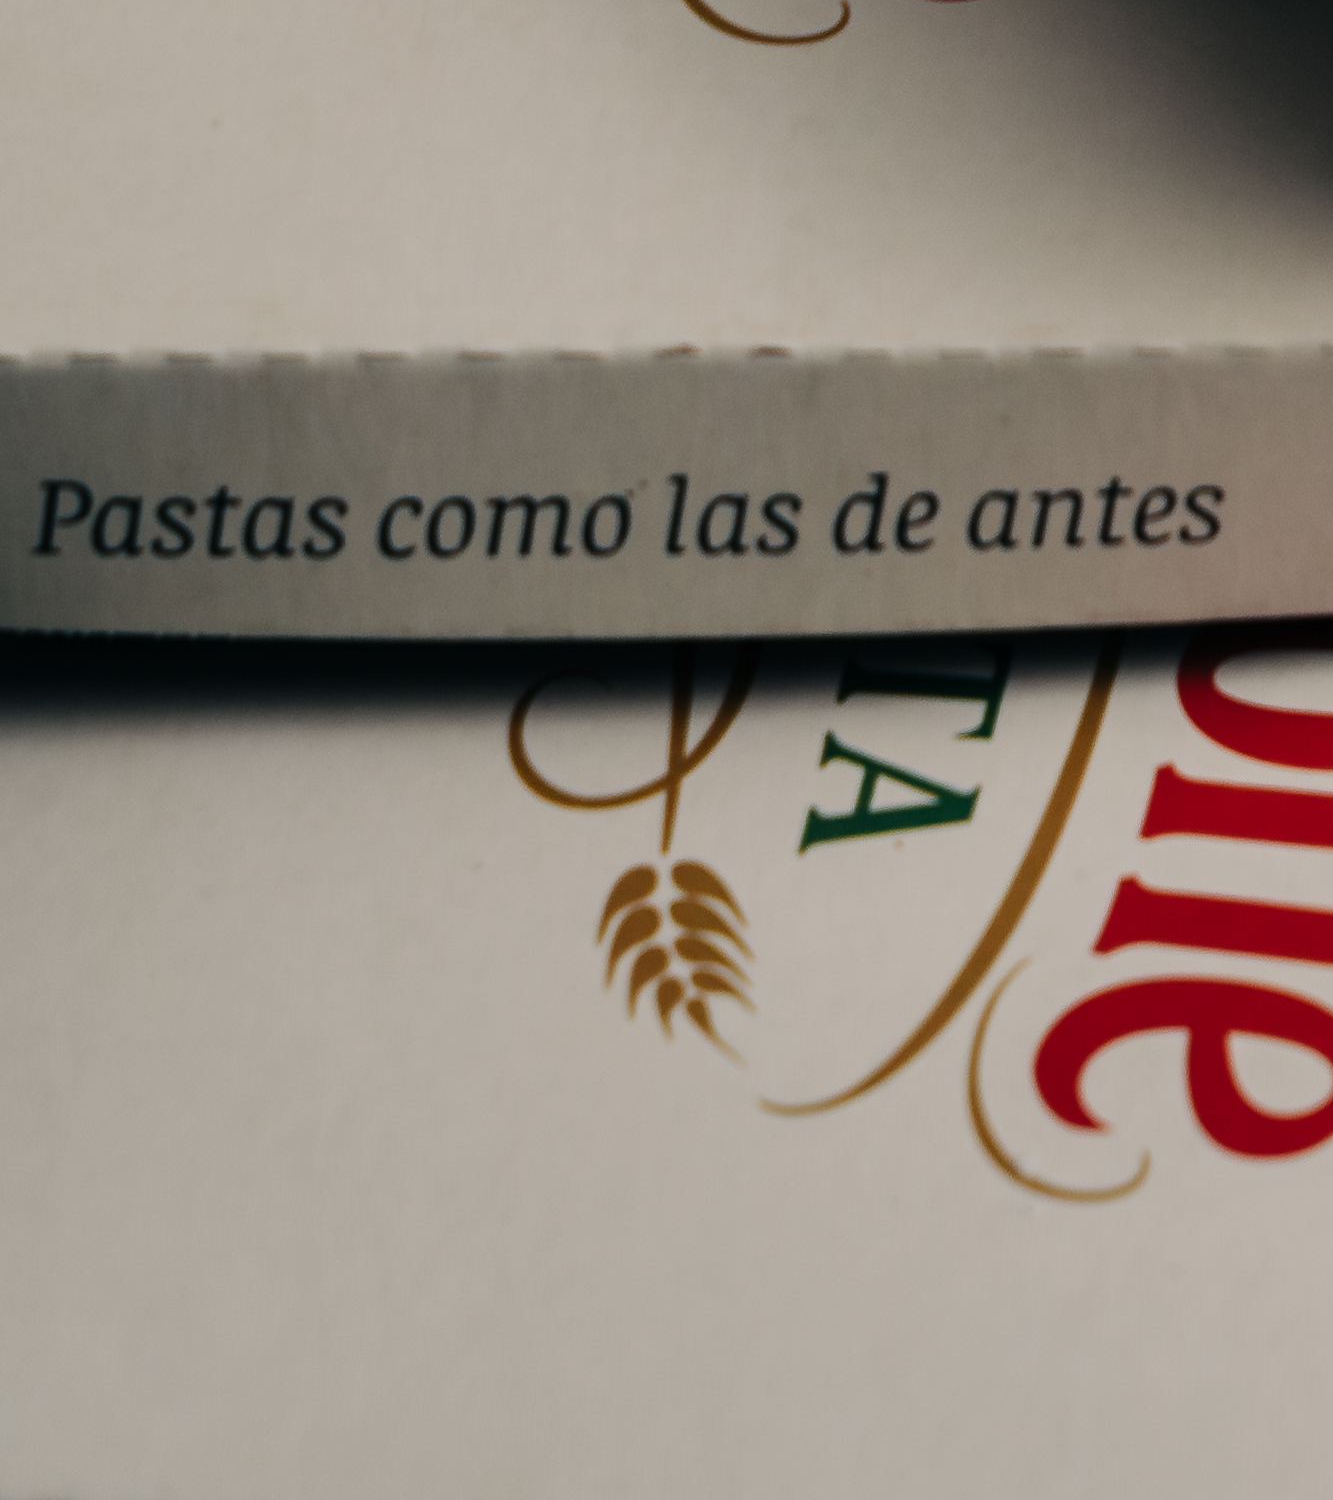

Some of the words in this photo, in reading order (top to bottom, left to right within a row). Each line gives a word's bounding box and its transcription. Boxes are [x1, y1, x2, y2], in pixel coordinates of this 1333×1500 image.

[33, 478, 348, 561] Pastas
[375, 491, 634, 561] como
[663, 471, 802, 558] las
[831, 470, 941, 554] de
[966, 473, 1225, 552] antes
